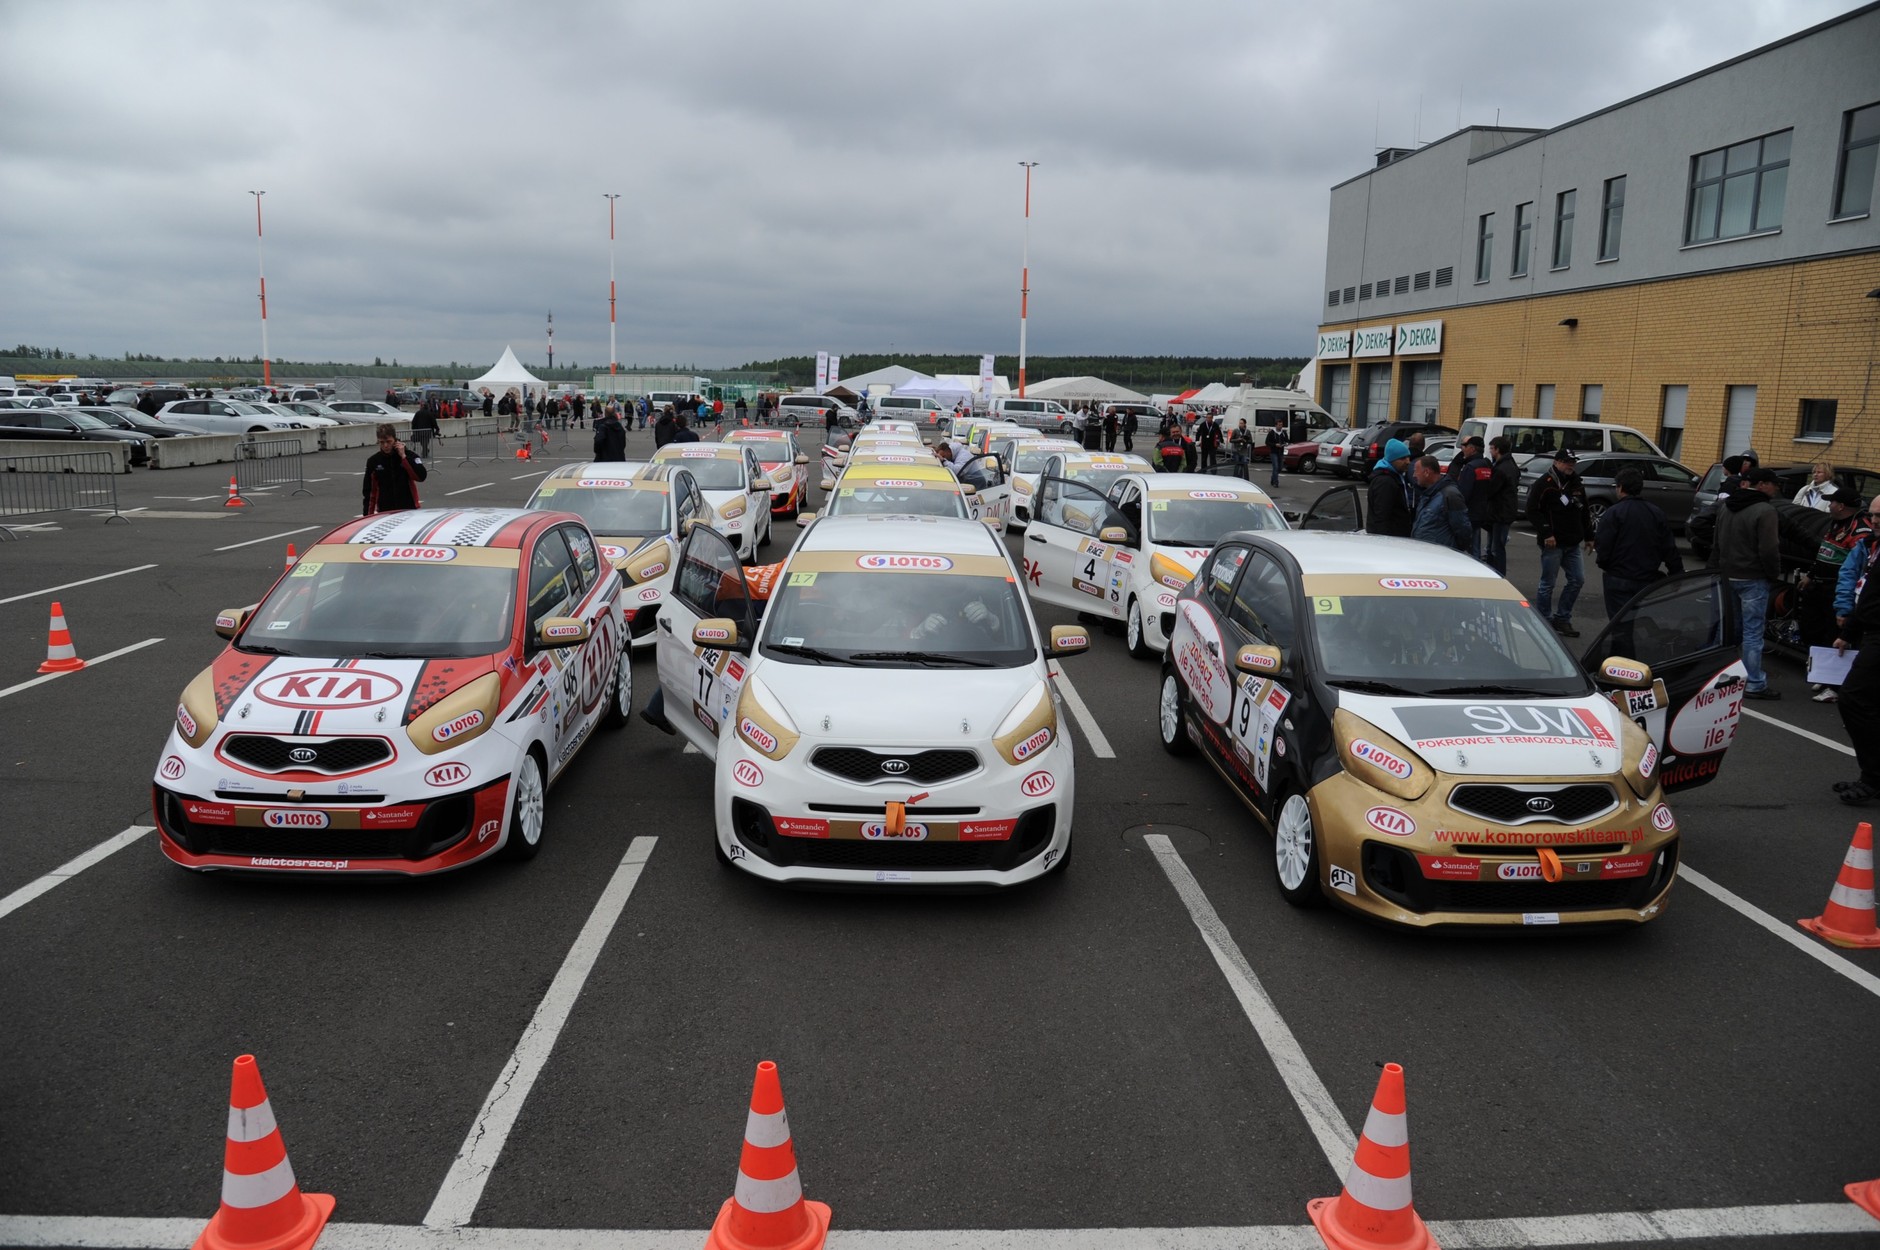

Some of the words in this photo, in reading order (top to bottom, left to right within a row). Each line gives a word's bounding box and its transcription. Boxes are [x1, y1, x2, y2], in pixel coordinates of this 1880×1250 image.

[1366, 331, 1389, 349] DEKRA
[1410, 327, 1437, 346] DEKRA
[1328, 337, 1347, 353] DEKRA
[594, 481, 626, 489] LOTOS
[1205, 491, 1233, 499] LOTOS
[391, 548, 446, 559] LOTOS
[1086, 545, 1105, 557] RACE
[297, 564, 318, 575] 98
[649, 565, 663, 574] LOTOS
[889, 556, 942, 569] LOTOS
[1084, 558, 1096, 581] 4
[792, 574, 814, 585] 17
[1168, 578, 1185, 588] LOTOS
[1402, 579, 1440, 589] LOTOS
[642, 591, 658, 600] KIA
[1161, 596, 1174, 605] KIA
[1318, 598, 1332, 612] 9
[557, 625, 579, 635] LOTOS
[705, 629, 726, 639] LOTOS
[1067, 637, 1085, 645] LOTOS
[1250, 655, 1272, 666] LOTOS
[1616, 670, 1639, 680] LOTOS
[278, 677, 372, 701] KIA
[563, 660, 578, 707] 98
[698, 664, 714, 707] 17
[1243, 676, 1263, 698] RACE
[1630, 693, 1655, 714] RACE
[1695, 690, 1715, 711] Nie
[180, 710, 195, 734] LOTOS
[450, 713, 479, 734] LOTOS
[1239, 697, 1250, 738] 9
[1462, 706, 1588, 737] SUM
[749, 730, 773, 749] LOTOS
[1026, 730, 1049, 752] LOTOS
[1417, 737, 1497, 750] POKROWCE
[1499, 737, 1618, 753] TERMOIZOLACYJNE
[1704, 728, 1725, 750] ile
[293, 750, 313, 760] KIA
[1368, 750, 1406, 775] LOTOS
[1645, 745, 1658, 769] LOTOS
[163, 757, 181, 775] KIA
[886, 761, 905, 771] KIA
[433, 766, 466, 784] KIA
[737, 763, 758, 785] KIA
[1026, 775, 1052, 794] KIA
[1531, 799, 1550, 809] KIA
[198, 808, 231, 818] Santander
[284, 814, 322, 826] LOTOS
[377, 811, 414, 820] Santander
[1656, 811, 1673, 827] KIA
[478, 820, 500, 837] ATT
[790, 821, 826, 831] Santander
[974, 824, 1009, 834] Santander
[1374, 811, 1407, 833] KIA
[1434, 828, 1645, 846] www.komorowskiteam.pl
[250, 857, 349, 871] kialotosrace.pl
[1442, 861, 1480, 872] Santander
[1613, 860, 1644, 872] Santander
[1331, 868, 1355, 886] ATT
